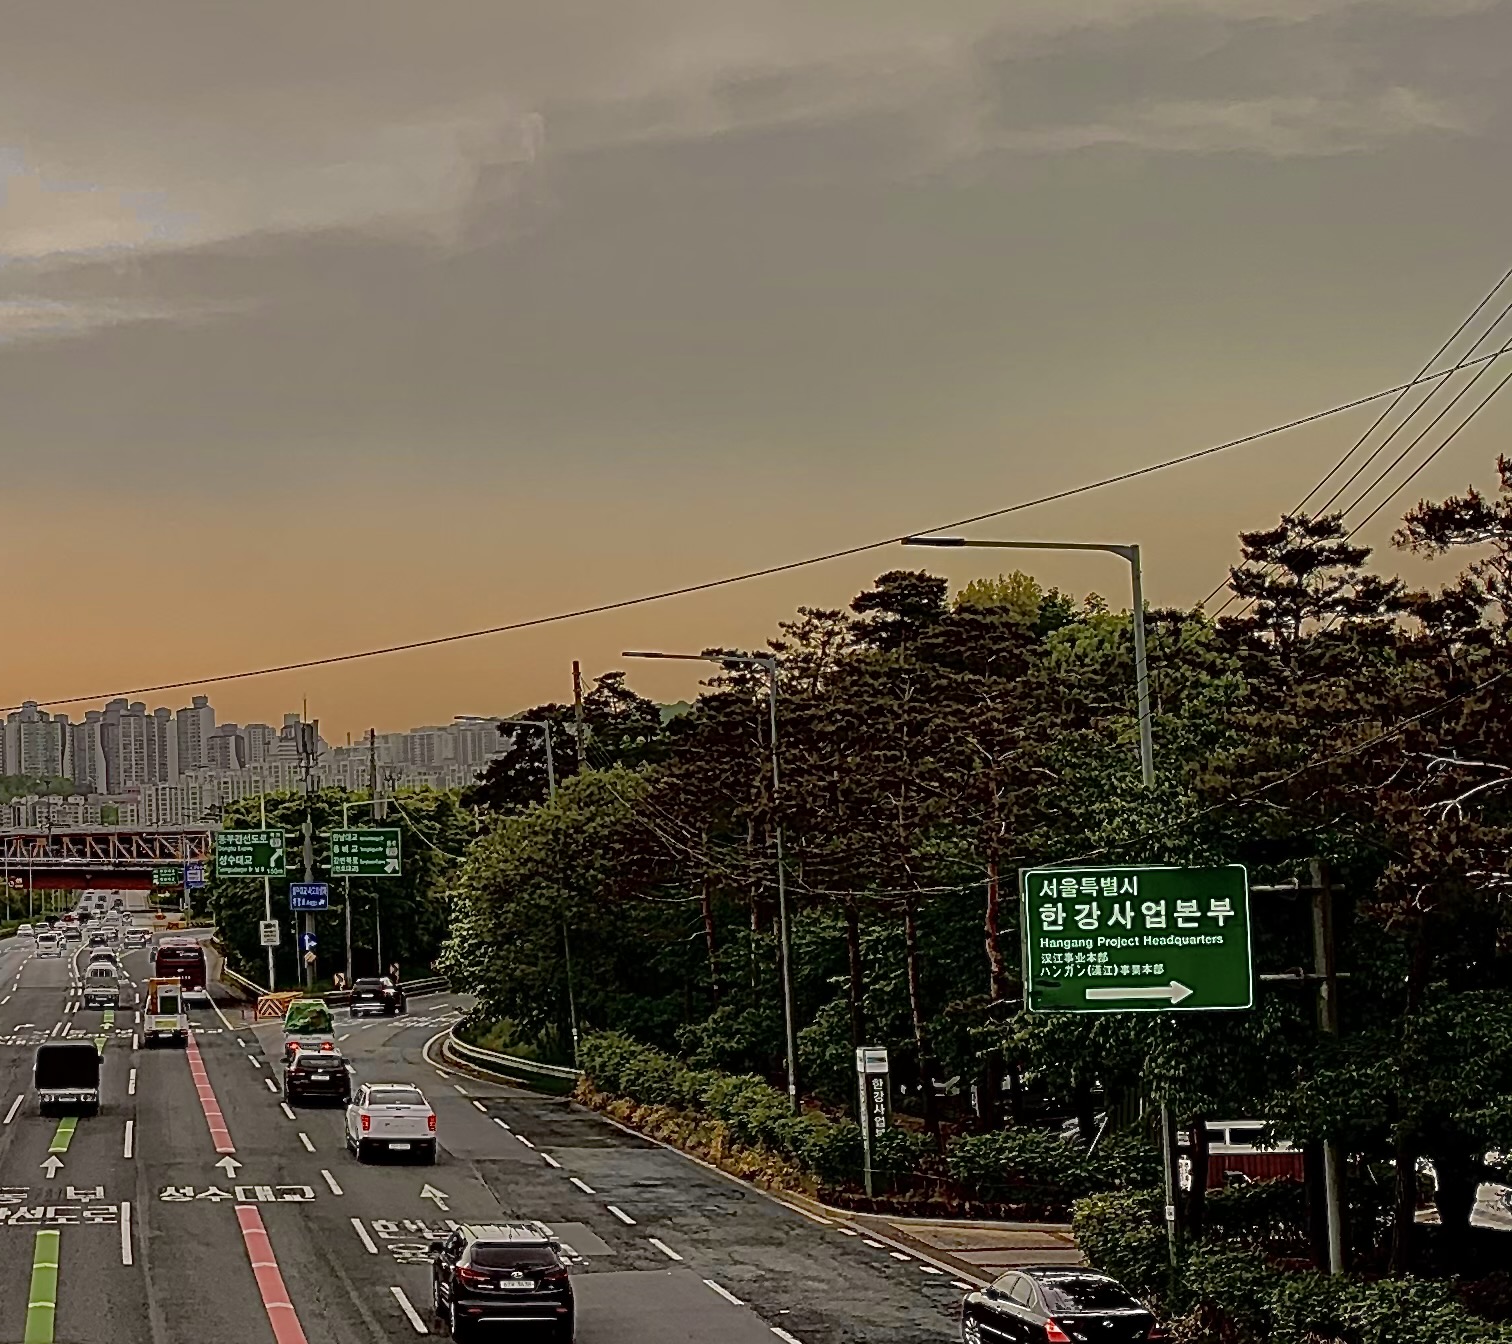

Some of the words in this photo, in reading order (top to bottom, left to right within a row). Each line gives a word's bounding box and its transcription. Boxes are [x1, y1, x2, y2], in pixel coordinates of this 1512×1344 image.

[1039, 875, 1138, 899] 서울특별시
[1039, 897, 1235, 931] 한강사업본부
[1040, 937, 1093, 950] Hangang
[1097, 935, 1140, 949] Project
[1143, 934, 1224, 947] Headquarters
[159, 1185, 316, 1202] 성수대교
